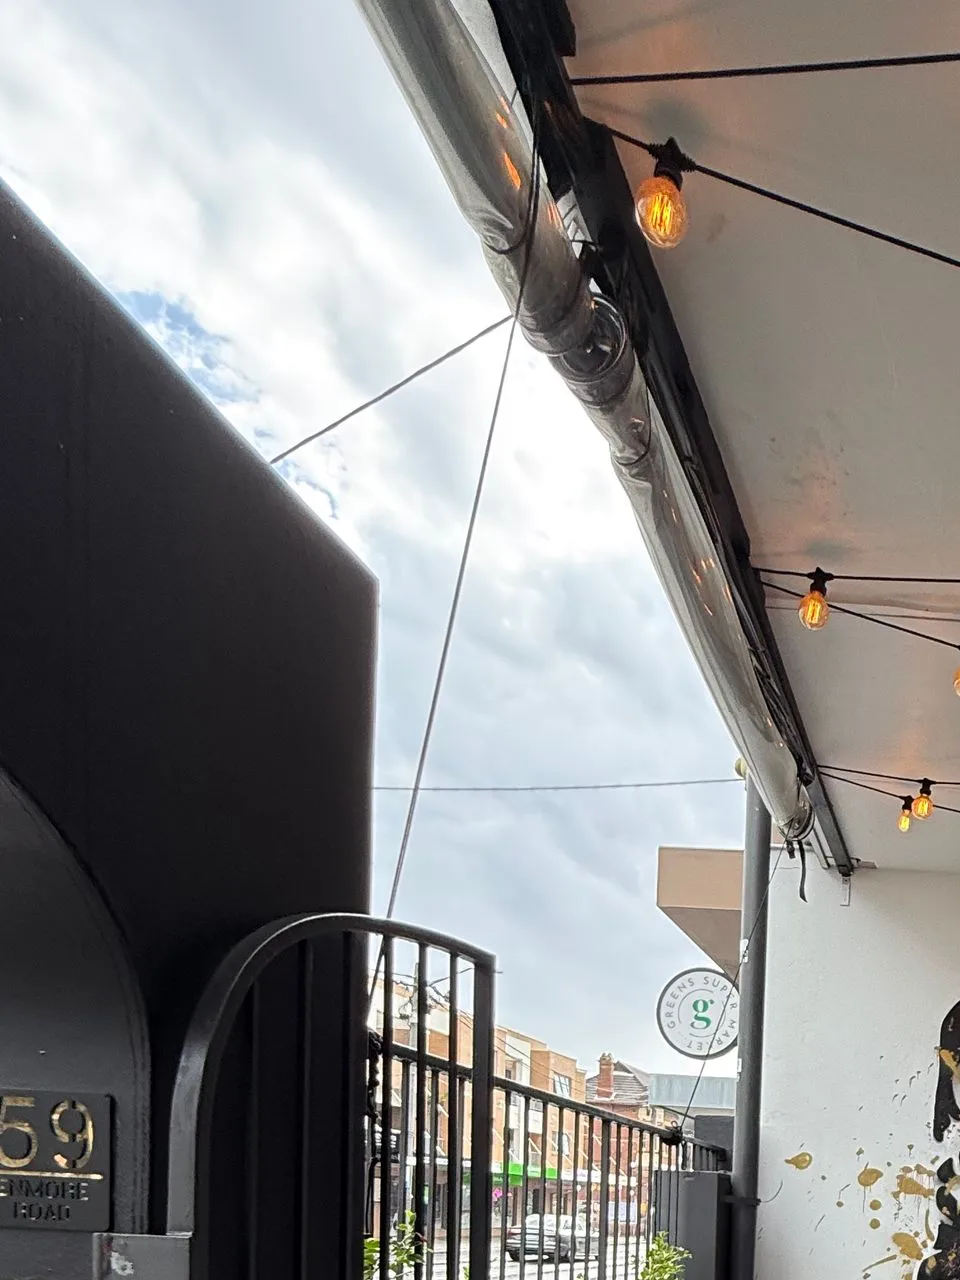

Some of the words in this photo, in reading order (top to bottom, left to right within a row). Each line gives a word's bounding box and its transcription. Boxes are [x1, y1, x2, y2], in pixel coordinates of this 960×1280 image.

[665, 977, 695, 1029] GREENS
[687, 1019, 737, 1051] MARET
[0, 1097, 94, 1169] 59
[13, 1201, 70, 1220] ROAD
